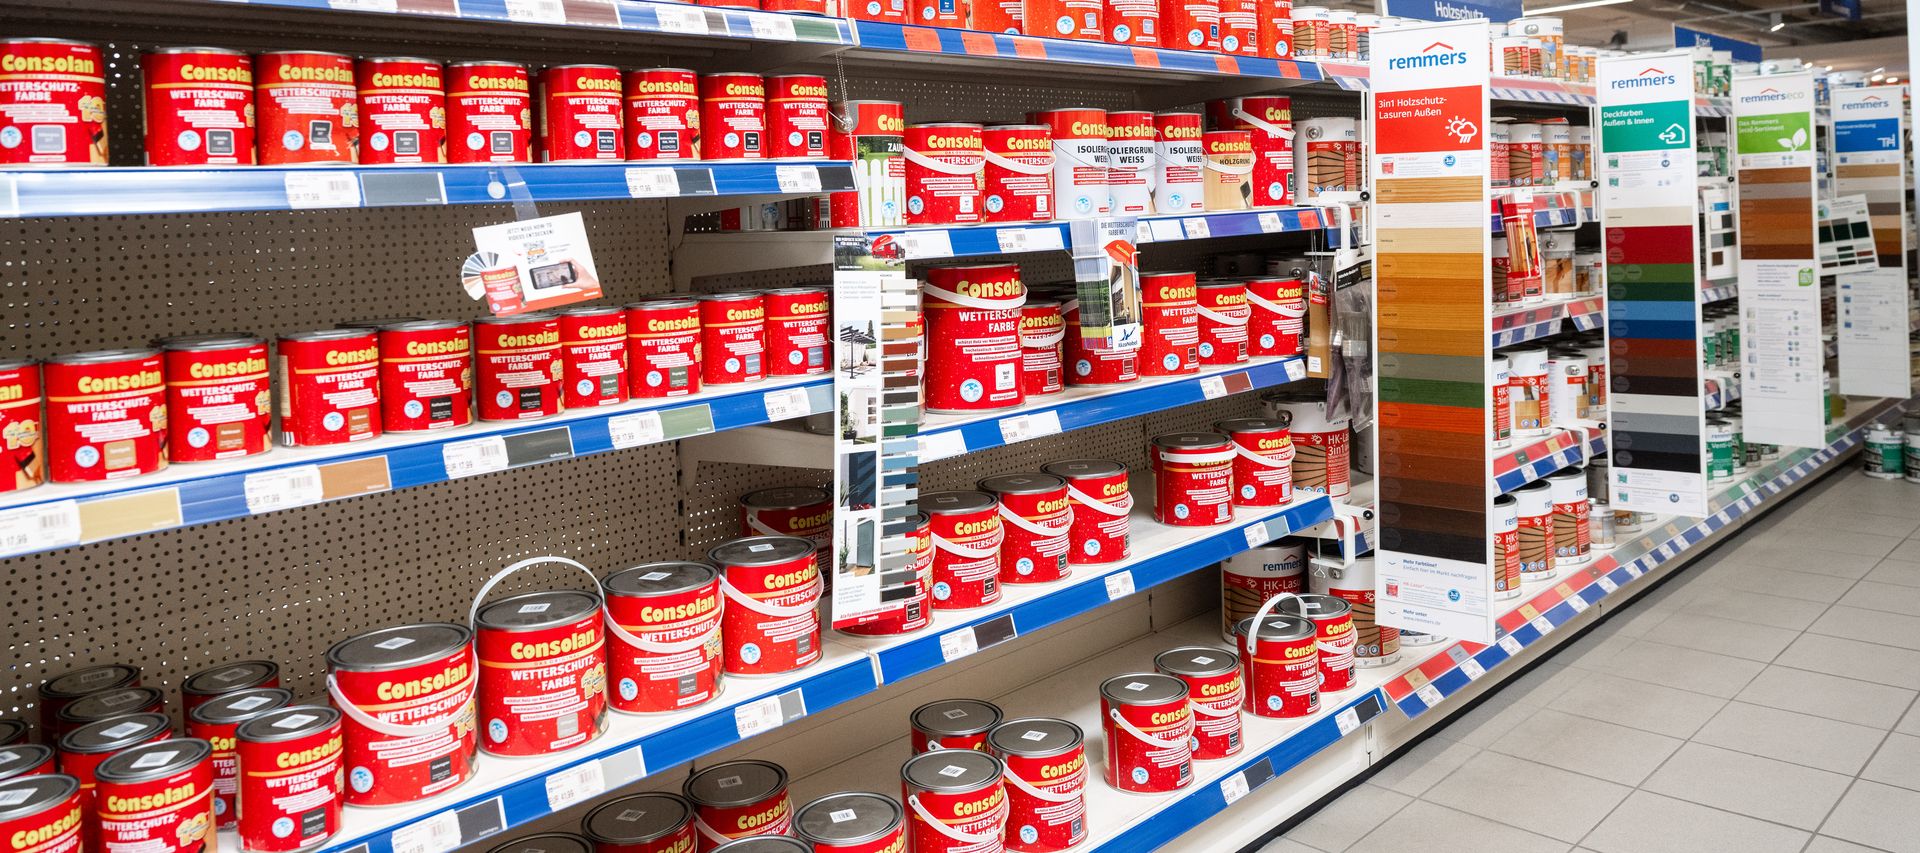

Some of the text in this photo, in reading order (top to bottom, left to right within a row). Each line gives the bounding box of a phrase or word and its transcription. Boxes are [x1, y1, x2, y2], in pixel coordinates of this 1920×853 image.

[2, 54, 94, 74] Consolan
[1389, 52, 1467, 70] remmers
[180, 64, 252, 82] Consolan
[279, 64, 353, 82] Consolan
[372, 72, 441, 89] Consolan
[469, 75, 528, 91] Consolan
[1611, 75, 1675, 89] remmers
[0, 82, 80, 93] ETTERSCHUTZ-
[639, 80, 695, 94] Consolan
[15, 91, 51, 102] FARBE
[364, 95, 432, 105] WETTERSCHUTZ-
[1378, 96, 1447, 108] 3in1 Holzschutz-
[194, 98, 226, 109] FARBE
[383, 102, 412, 112] FARBE
[479, 103, 506, 113] FARBE
[587, 103, 609, 113] FARBE
[632, 100, 688, 109] WETTERSCHUTZ-
[1842, 100, 1889, 110] remmers
[647, 106, 671, 115] FARBE
[735, 108, 755, 116] FARBE
[799, 108, 817, 116] FARBE
[1379, 107, 1442, 119] Lasuren Außen
[1603, 109, 1643, 118] Deckfarben
[1604, 119, 1626, 127] Außen
[1634, 117, 1654, 125] Innen
[927, 135, 983, 149] Consolan
[1120, 155, 1144, 164] WEISS
[648, 316, 699, 331] Consolan
[988, 321, 1015, 333] FARBE
[799, 326, 818, 334] FARBE
[498, 330, 559, 348] Consolan
[640, 336, 695, 347] WETTERSCHUTZ-
[736, 332, 755, 341] FARBE
[407, 338, 468, 355] Consolan
[658, 344, 680, 353] FARBE
[490, 352, 552, 364] WETTERSCHUTZ-
[589, 352, 611, 360] FARBE
[190, 358, 267, 379] Consolan
[398, 360, 462, 373] WETTERSCHUTZ-
[508, 362, 533, 371] FARBE
[418, 370, 445, 380] FARBE
[78, 371, 161, 393] Consolan
[338, 379, 365, 390] FARBE
[180, 381, 258, 398] WETTERSCHUTZ-
[203, 393, 235, 404] FARBE
[67, 396, 152, 414] WETTERSCHUTZ-
[91, 409, 127, 421] FARBE
[1328, 443, 1345, 456] 3in1
[641, 594, 715, 623] Consolan
[641, 619, 717, 642] WETTERSCHUTZ-
[510, 629, 595, 660] Consolan
[511, 654, 596, 680] WETTERSCHUTZ-
[377, 663, 468, 701] Consolan
[377, 690, 469, 723] WETTERSCHUTZ-
[289, 778, 319, 793] FARBE
[107, 782, 195, 812] Consolan
[101, 813, 179, 830] WETTERSCHUTZ-
[118, 830, 150, 840] FARBE
